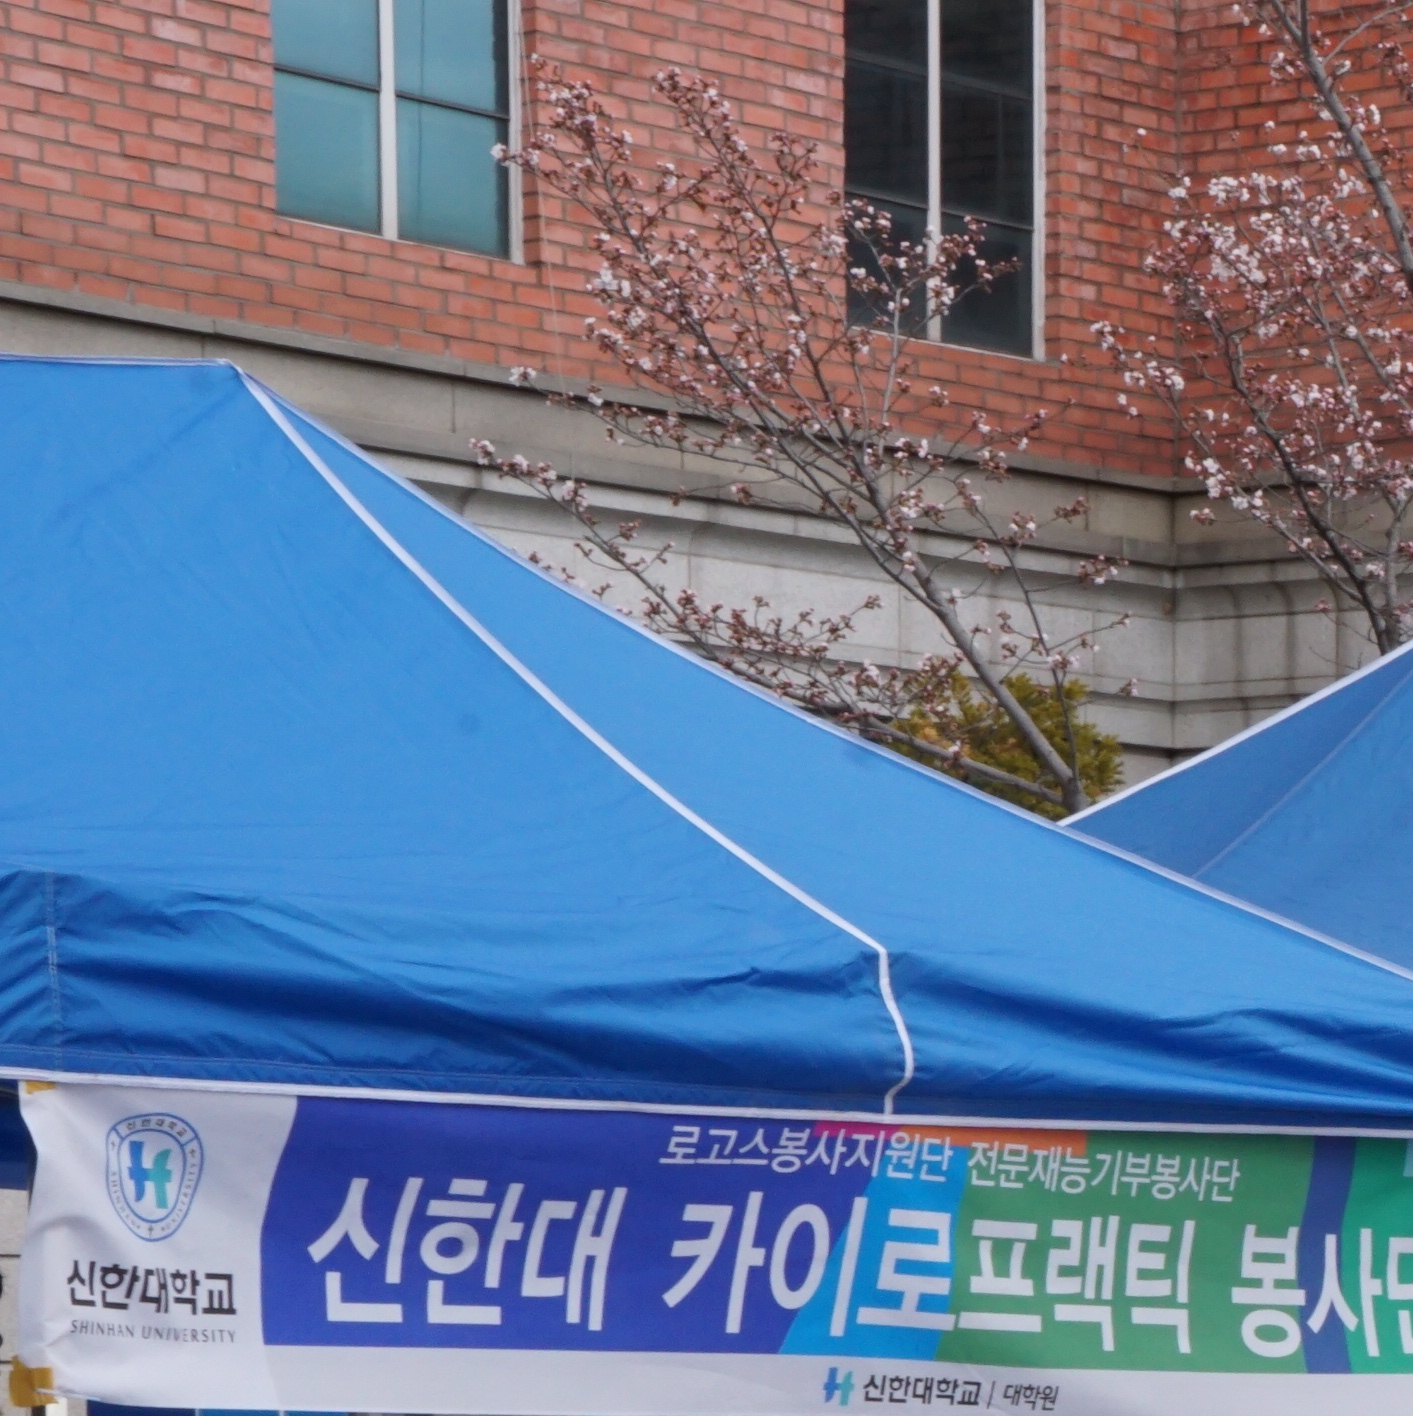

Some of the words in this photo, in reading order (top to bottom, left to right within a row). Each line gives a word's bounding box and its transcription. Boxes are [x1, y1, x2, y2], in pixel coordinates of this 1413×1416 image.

[659, 1125, 952, 1181] 로고스봉사지원단
[966, 1140, 1241, 1203] 전문재능기부봉사단
[67, 1259, 237, 1316] 신한대학교
[307, 1176, 628, 1332] 신한대
[661, 1190, 1196, 1356] 카이로프랙틱
[70, 1318, 135, 1339] SHINHAN
[141, 1324, 237, 1344] UNIVERSITY
[862, 1373, 983, 1407] 신한대학교
[1001, 1382, 1060, 1412] 대학원
